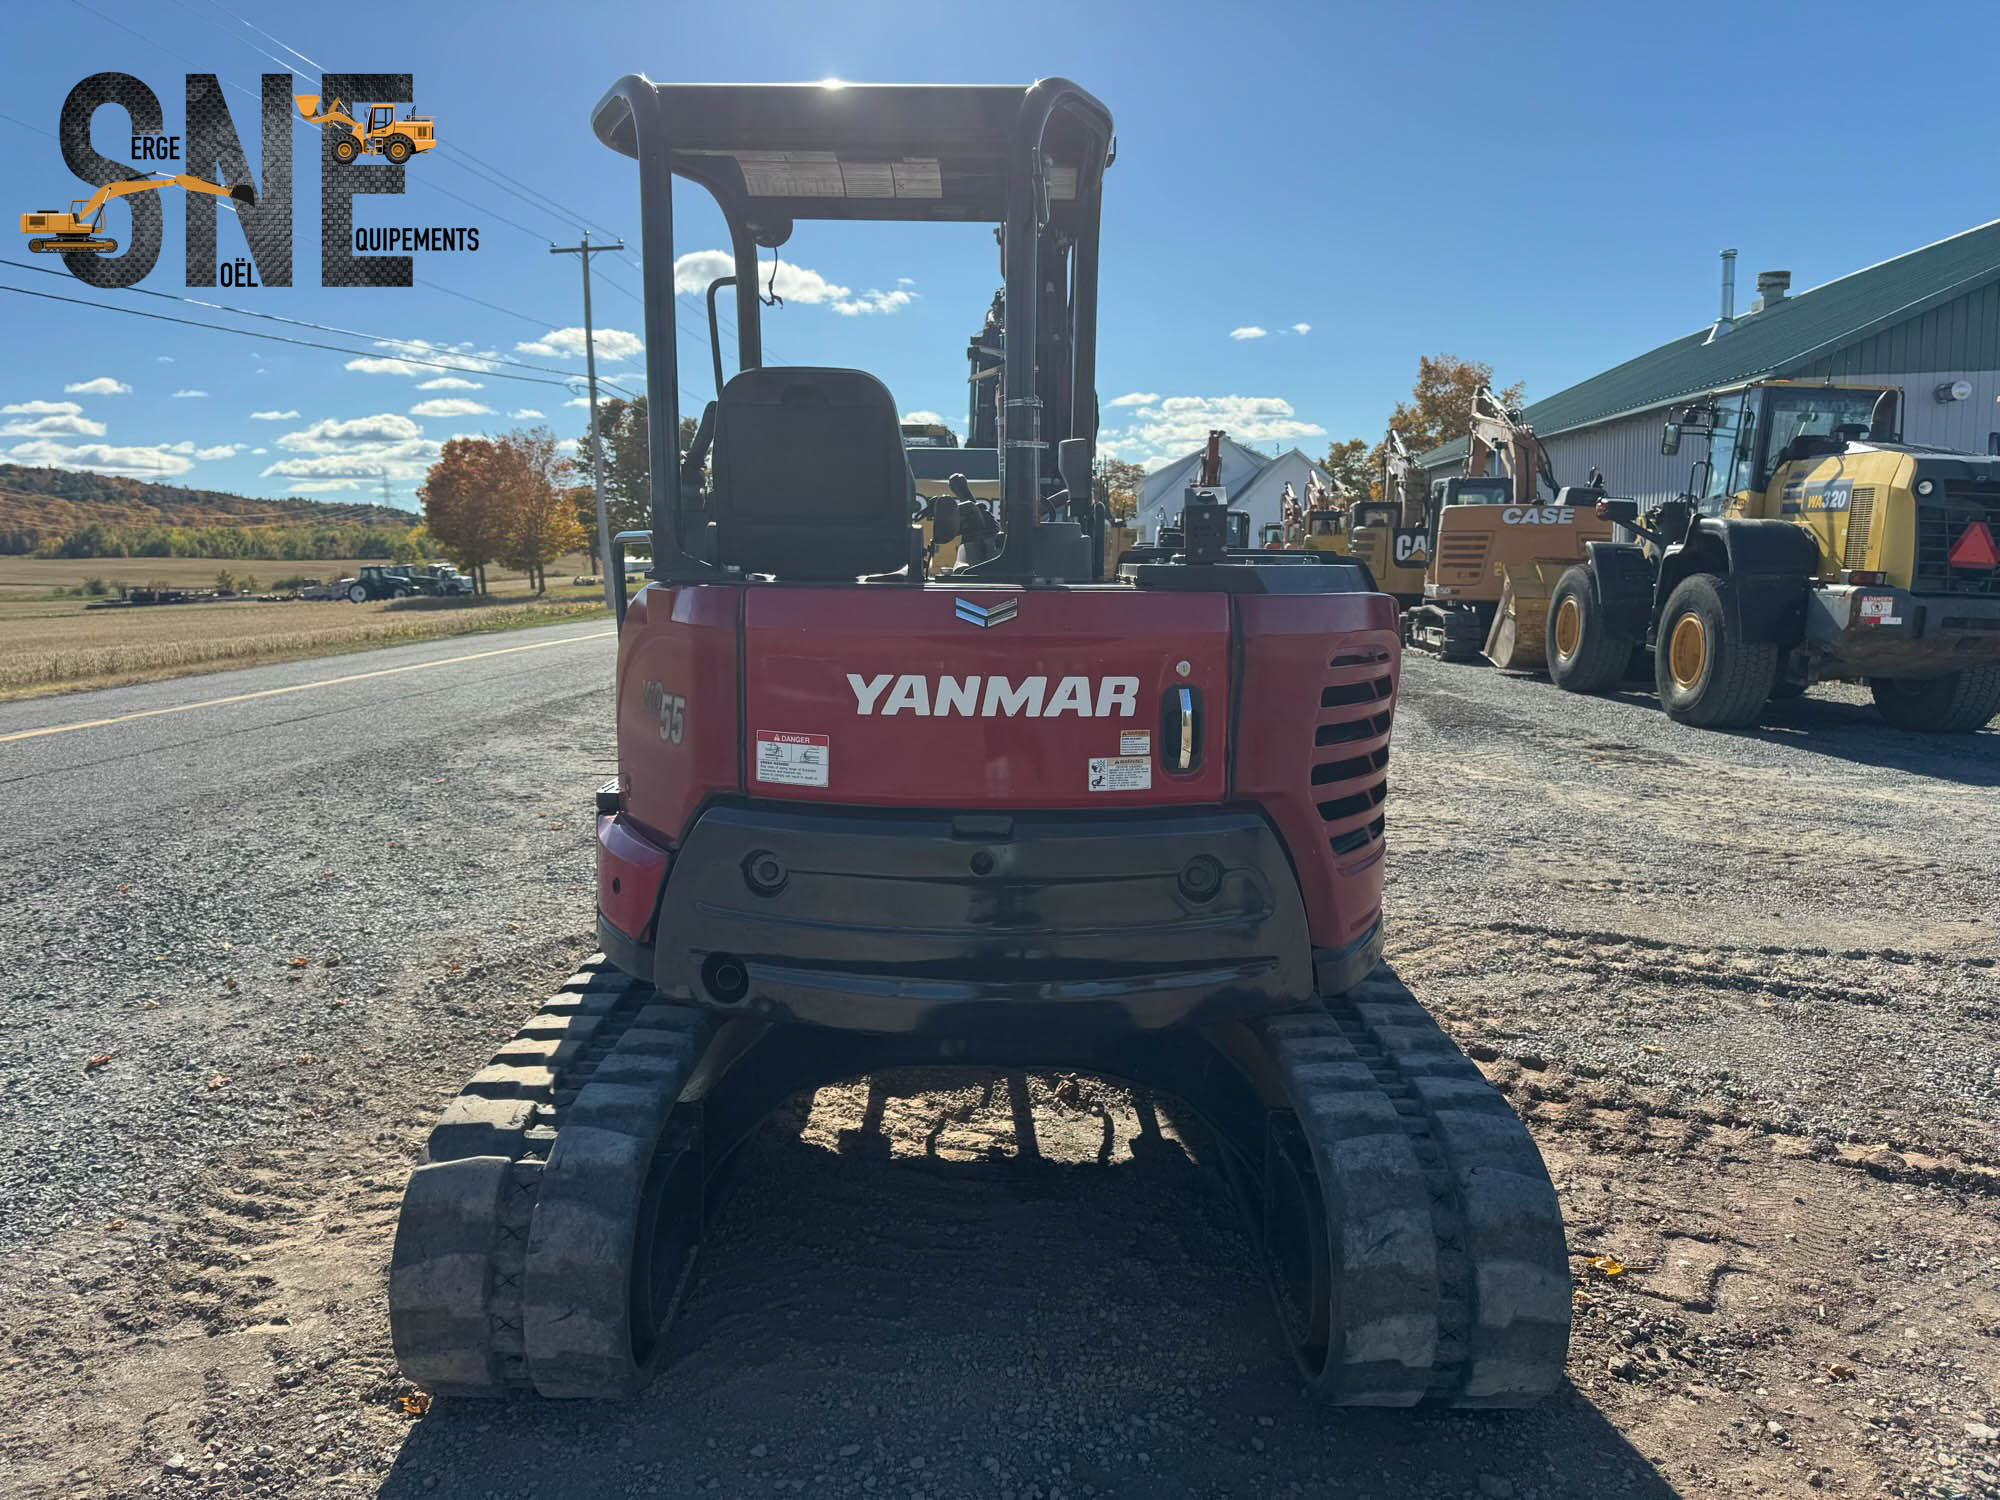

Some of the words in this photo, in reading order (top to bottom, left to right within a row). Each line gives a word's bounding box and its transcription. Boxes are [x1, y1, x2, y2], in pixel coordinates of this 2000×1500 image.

[1807, 490, 1847, 509] WA320
[1502, 507, 1576, 525] CASE
[1396, 534, 1427, 561] CA
[846, 674, 1140, 717] YANMAR
[781, 735, 810, 744] DANGER
